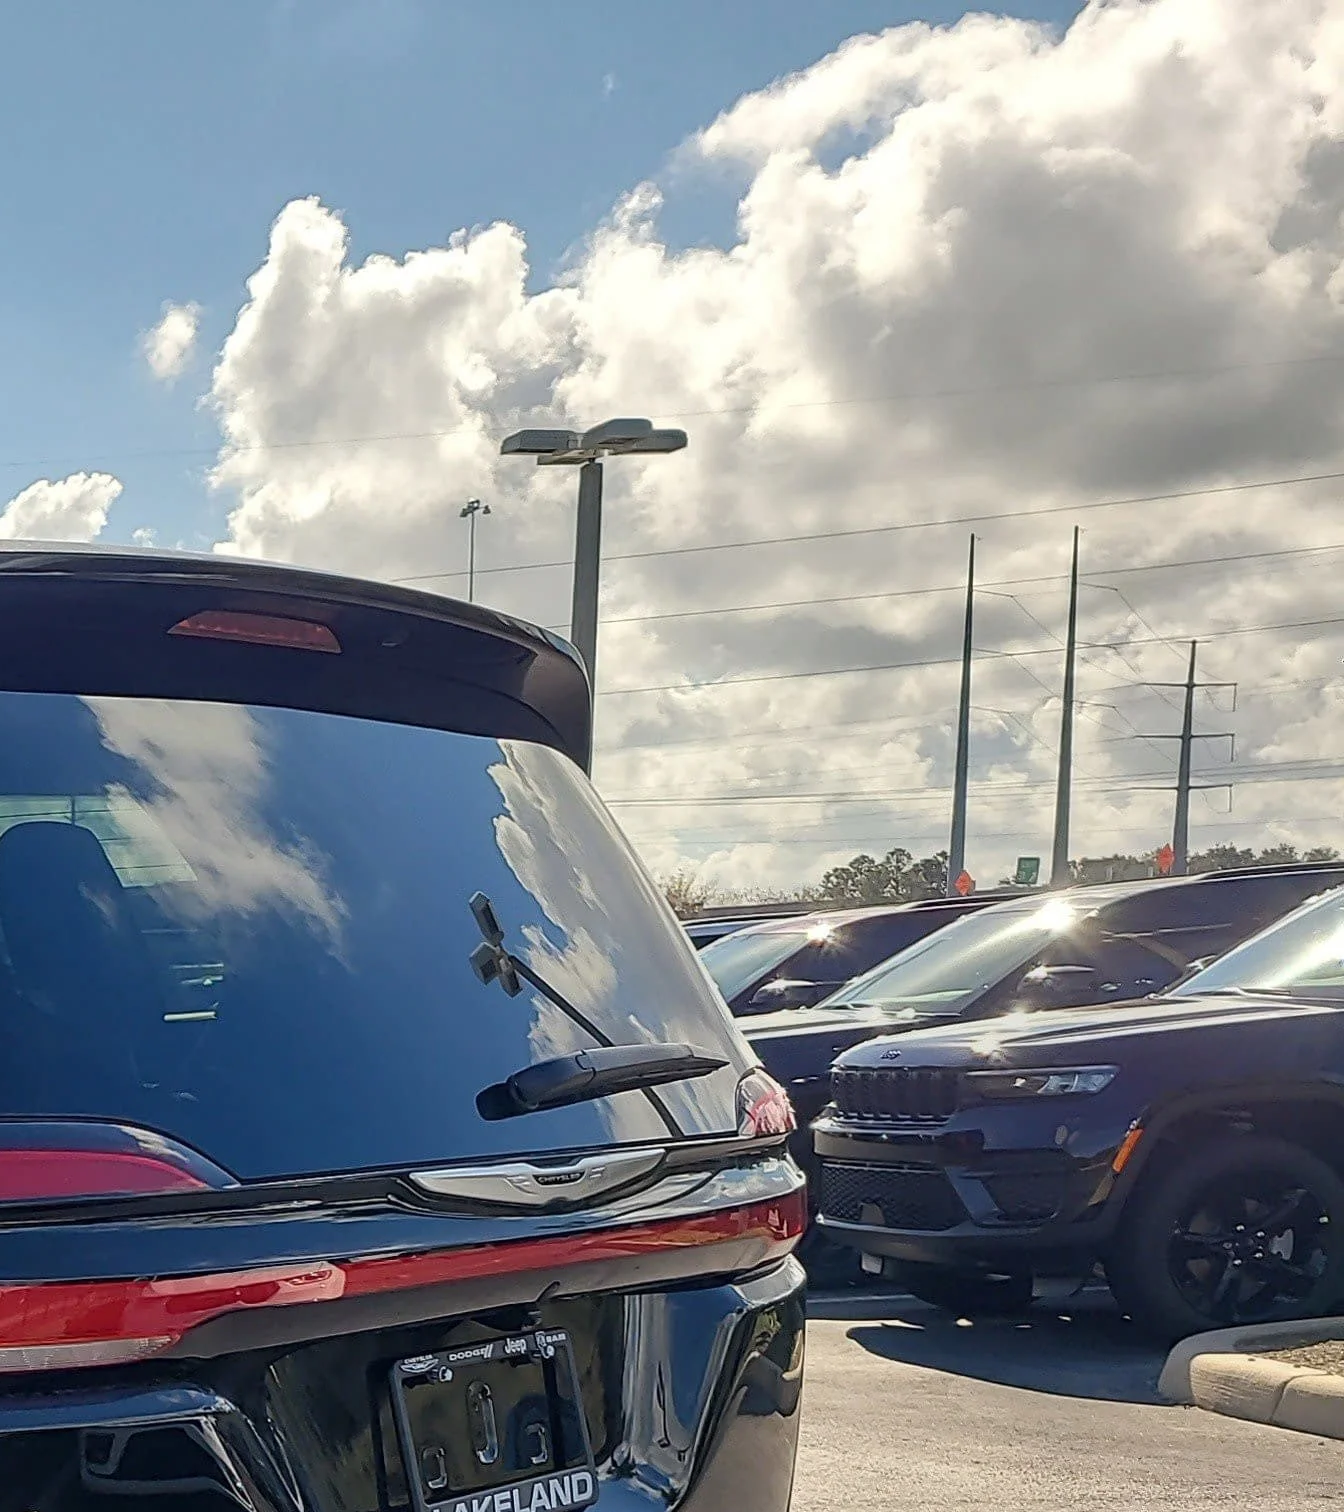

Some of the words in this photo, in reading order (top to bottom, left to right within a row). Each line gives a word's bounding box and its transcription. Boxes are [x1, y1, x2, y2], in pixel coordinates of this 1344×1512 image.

[448, 1344, 488, 1361] DODGE
[504, 1338, 527, 1354] Jeep
[546, 1333, 566, 1343] RAM
